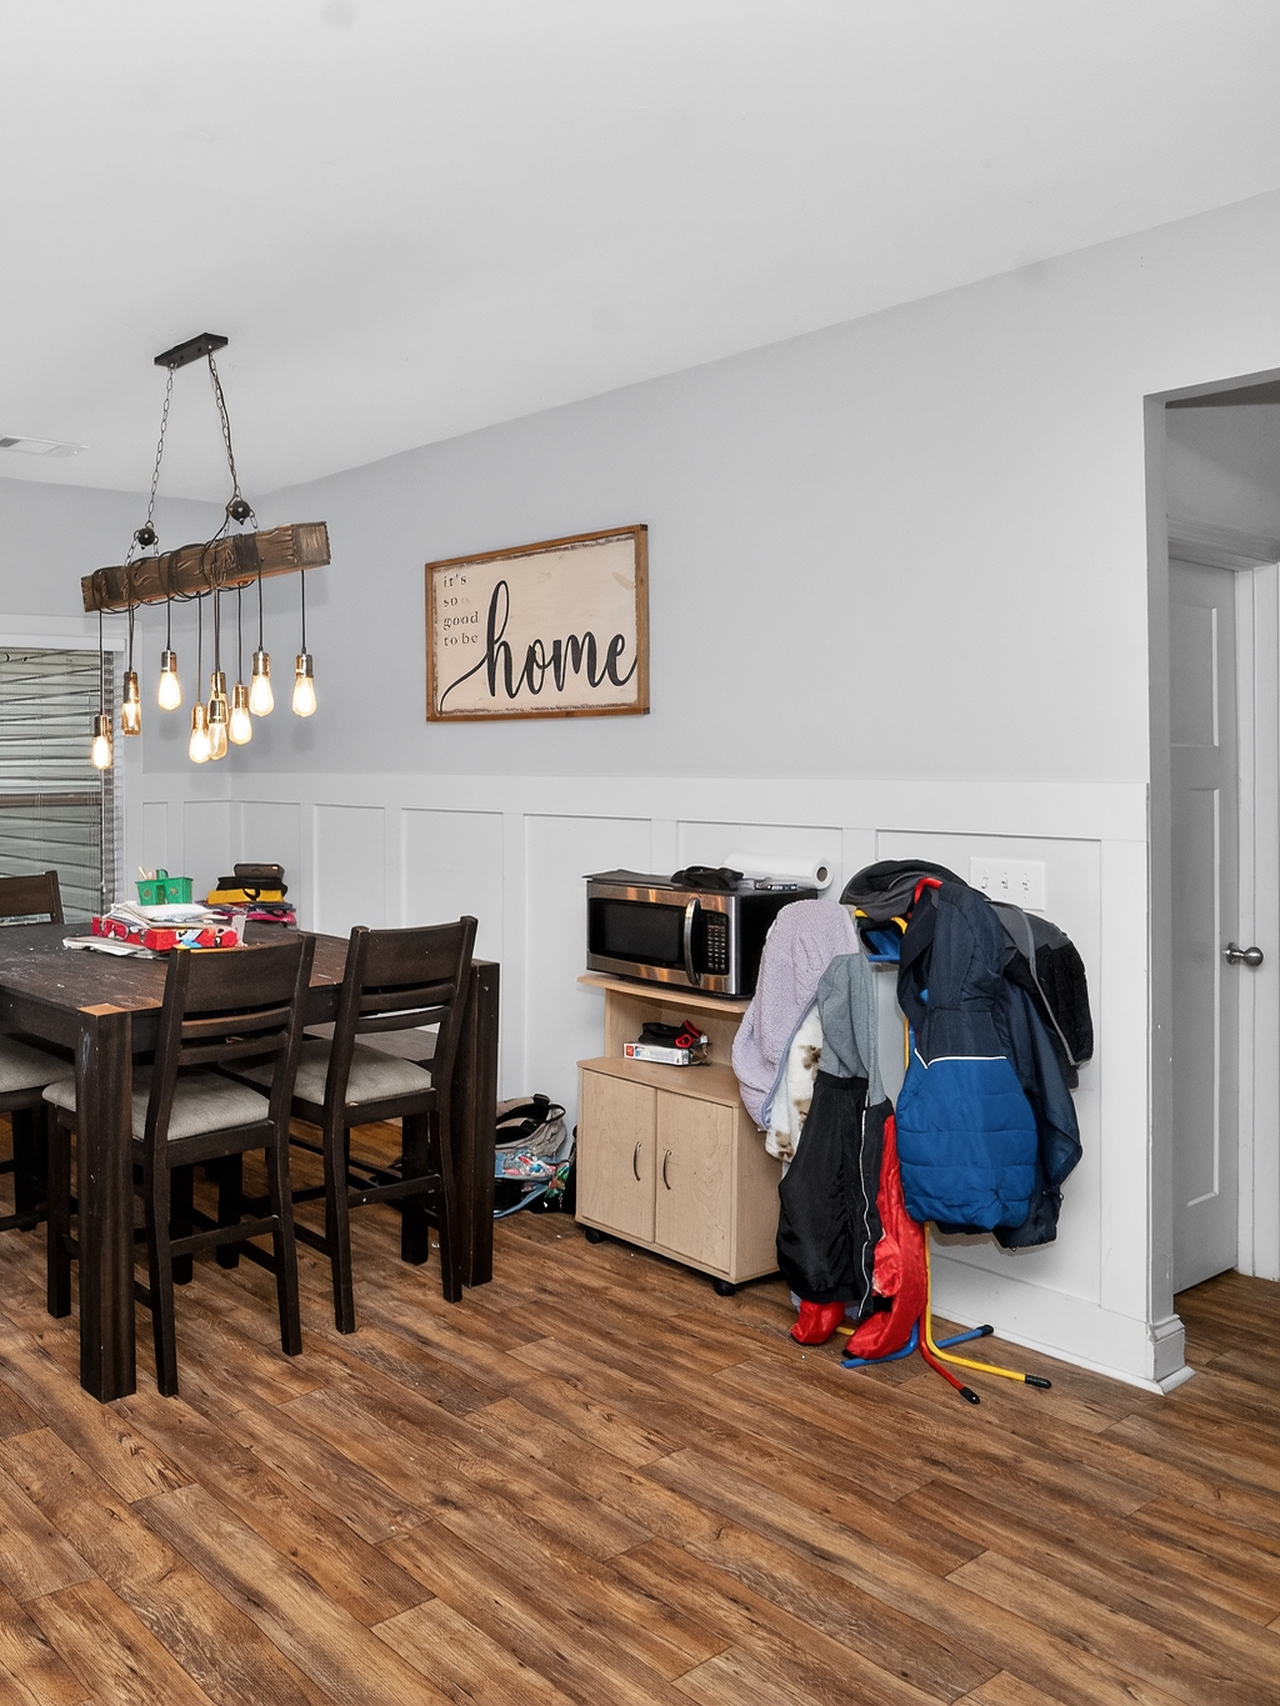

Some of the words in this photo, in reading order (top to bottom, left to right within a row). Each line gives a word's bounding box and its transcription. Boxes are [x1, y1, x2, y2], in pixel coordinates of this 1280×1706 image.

[443, 572, 467, 588] it's
[443, 596, 459, 608] so
[443, 611, 479, 631] good
[440, 580, 637, 713] home
[444, 636, 458, 647] to
[461, 632, 479, 645] be
